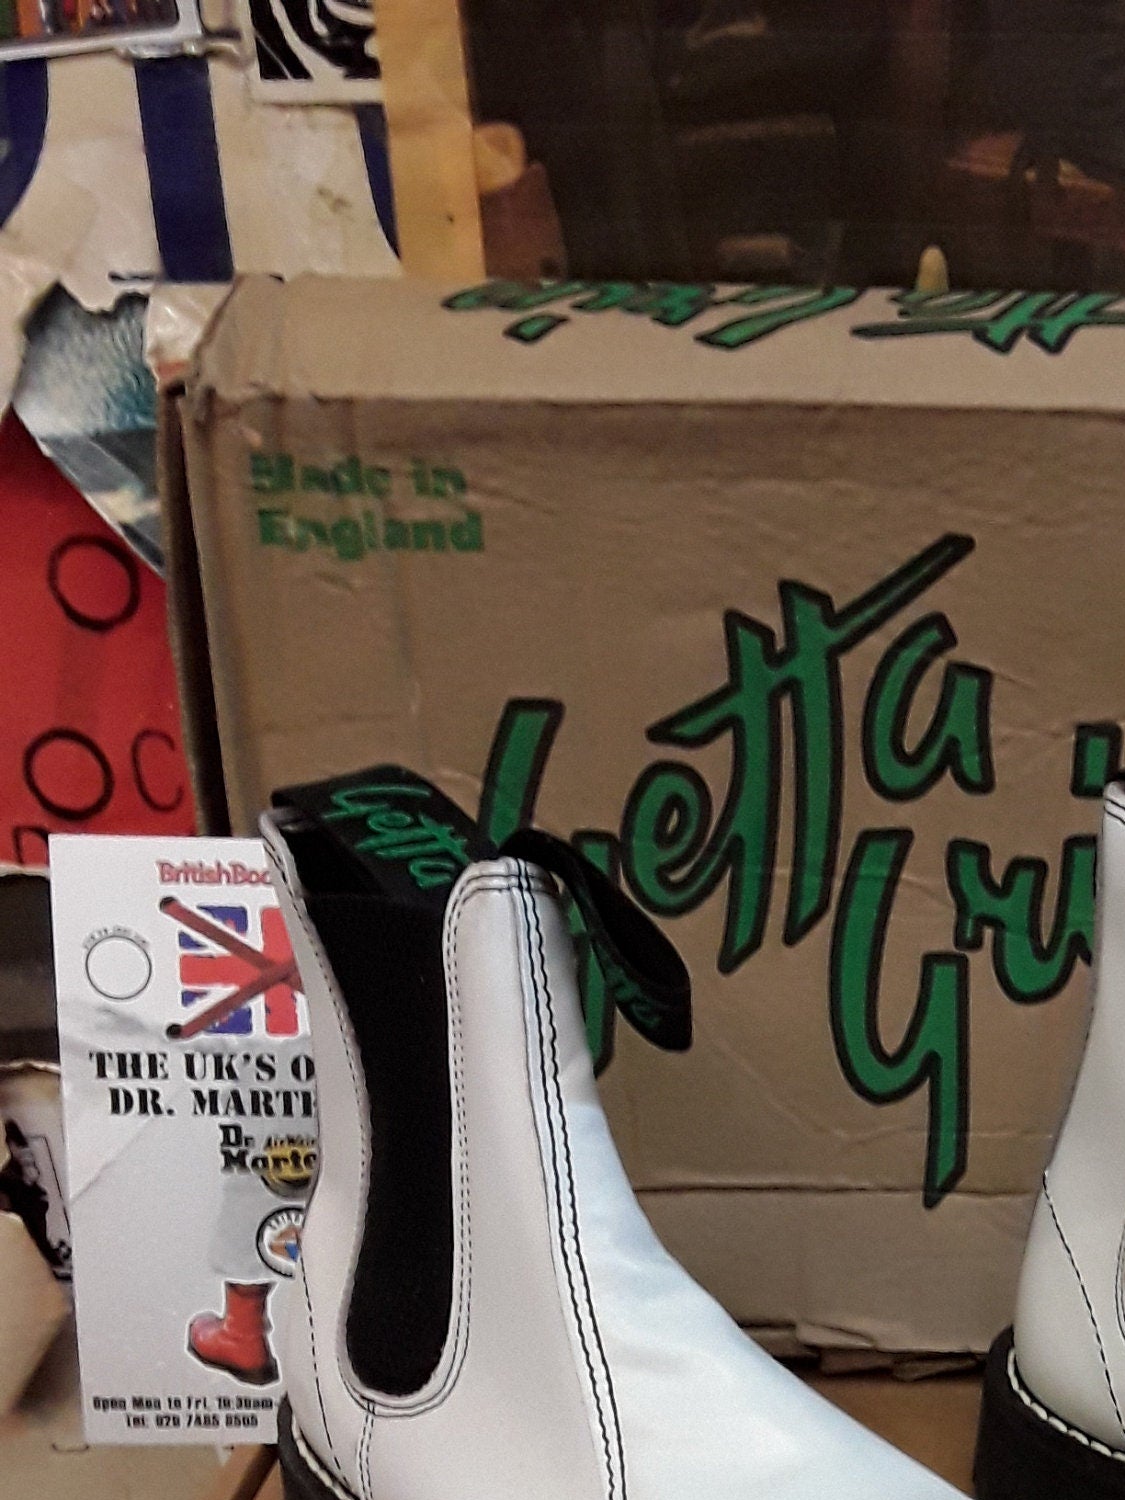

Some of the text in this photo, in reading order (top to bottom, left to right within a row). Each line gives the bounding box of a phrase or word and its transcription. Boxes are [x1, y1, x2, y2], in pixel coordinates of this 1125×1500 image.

[409, 457, 467, 497] in
[258, 508, 486, 561] England
[90, 1052, 168, 1080] THE
[184, 1053, 277, 1081] UK'S
[109, 1087, 174, 1116] DR.
